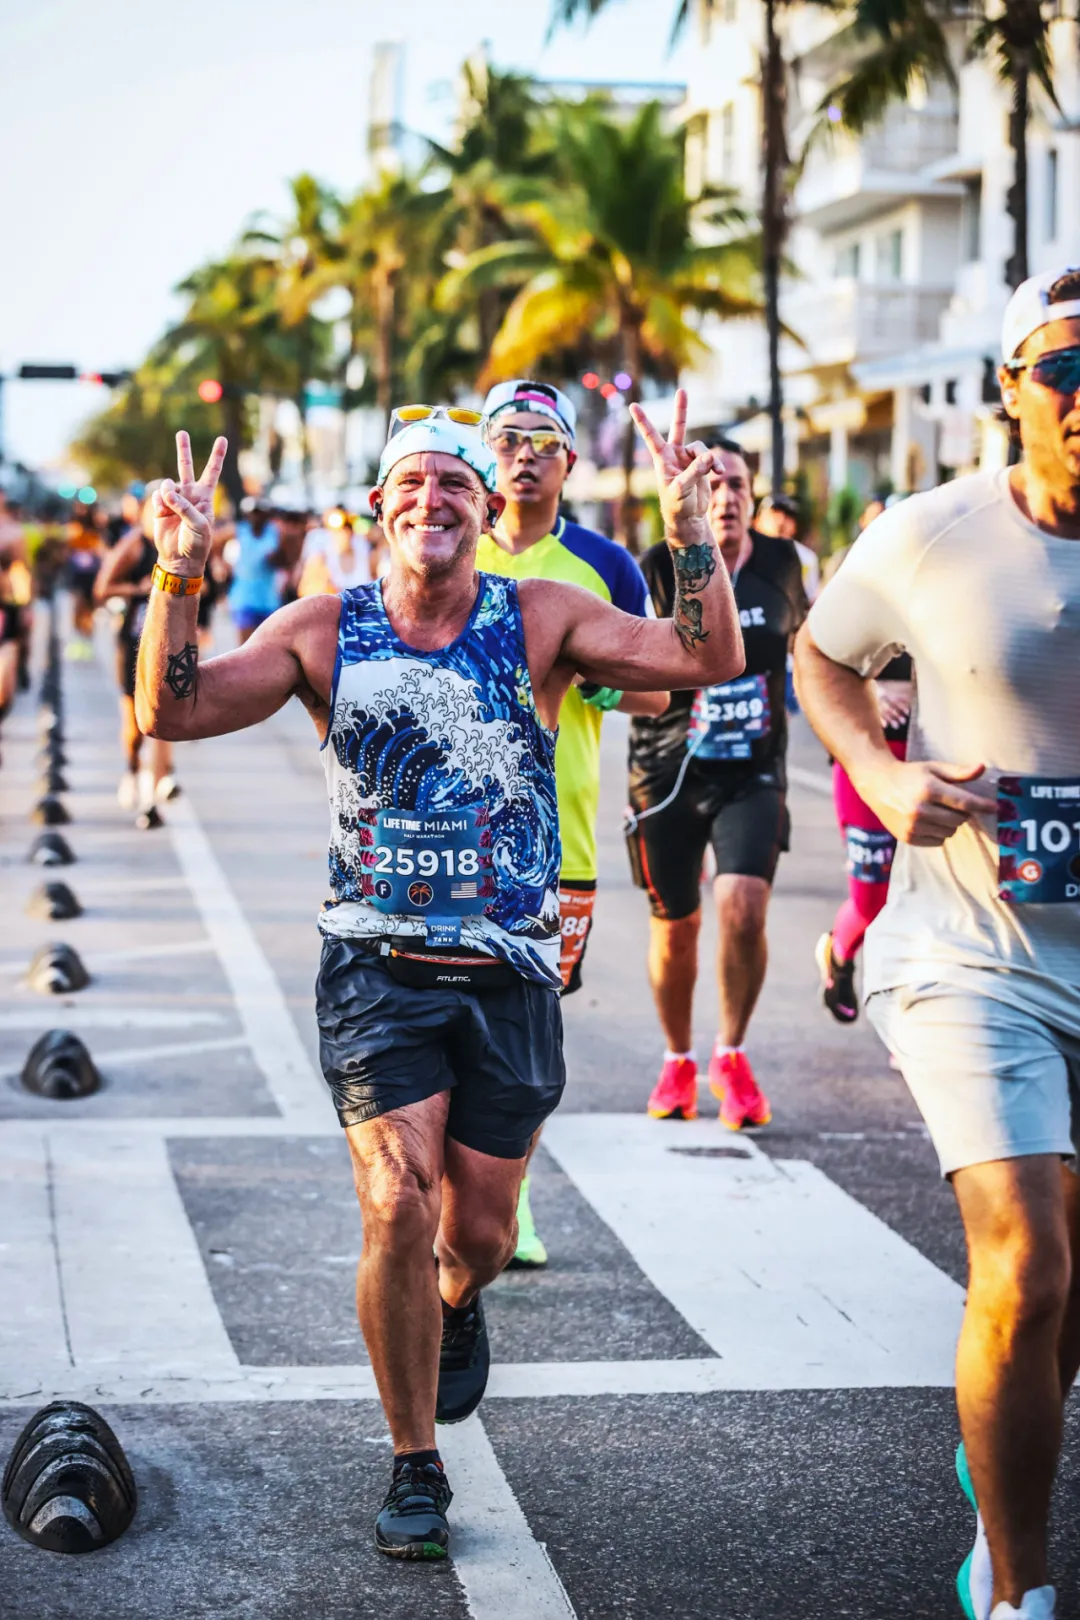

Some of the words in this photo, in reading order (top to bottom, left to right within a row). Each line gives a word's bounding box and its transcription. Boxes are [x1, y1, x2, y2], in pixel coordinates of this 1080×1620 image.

[424, 820, 467, 831] MIAMI
[374, 846, 480, 876] 25918
[380, 884, 387, 895] F
